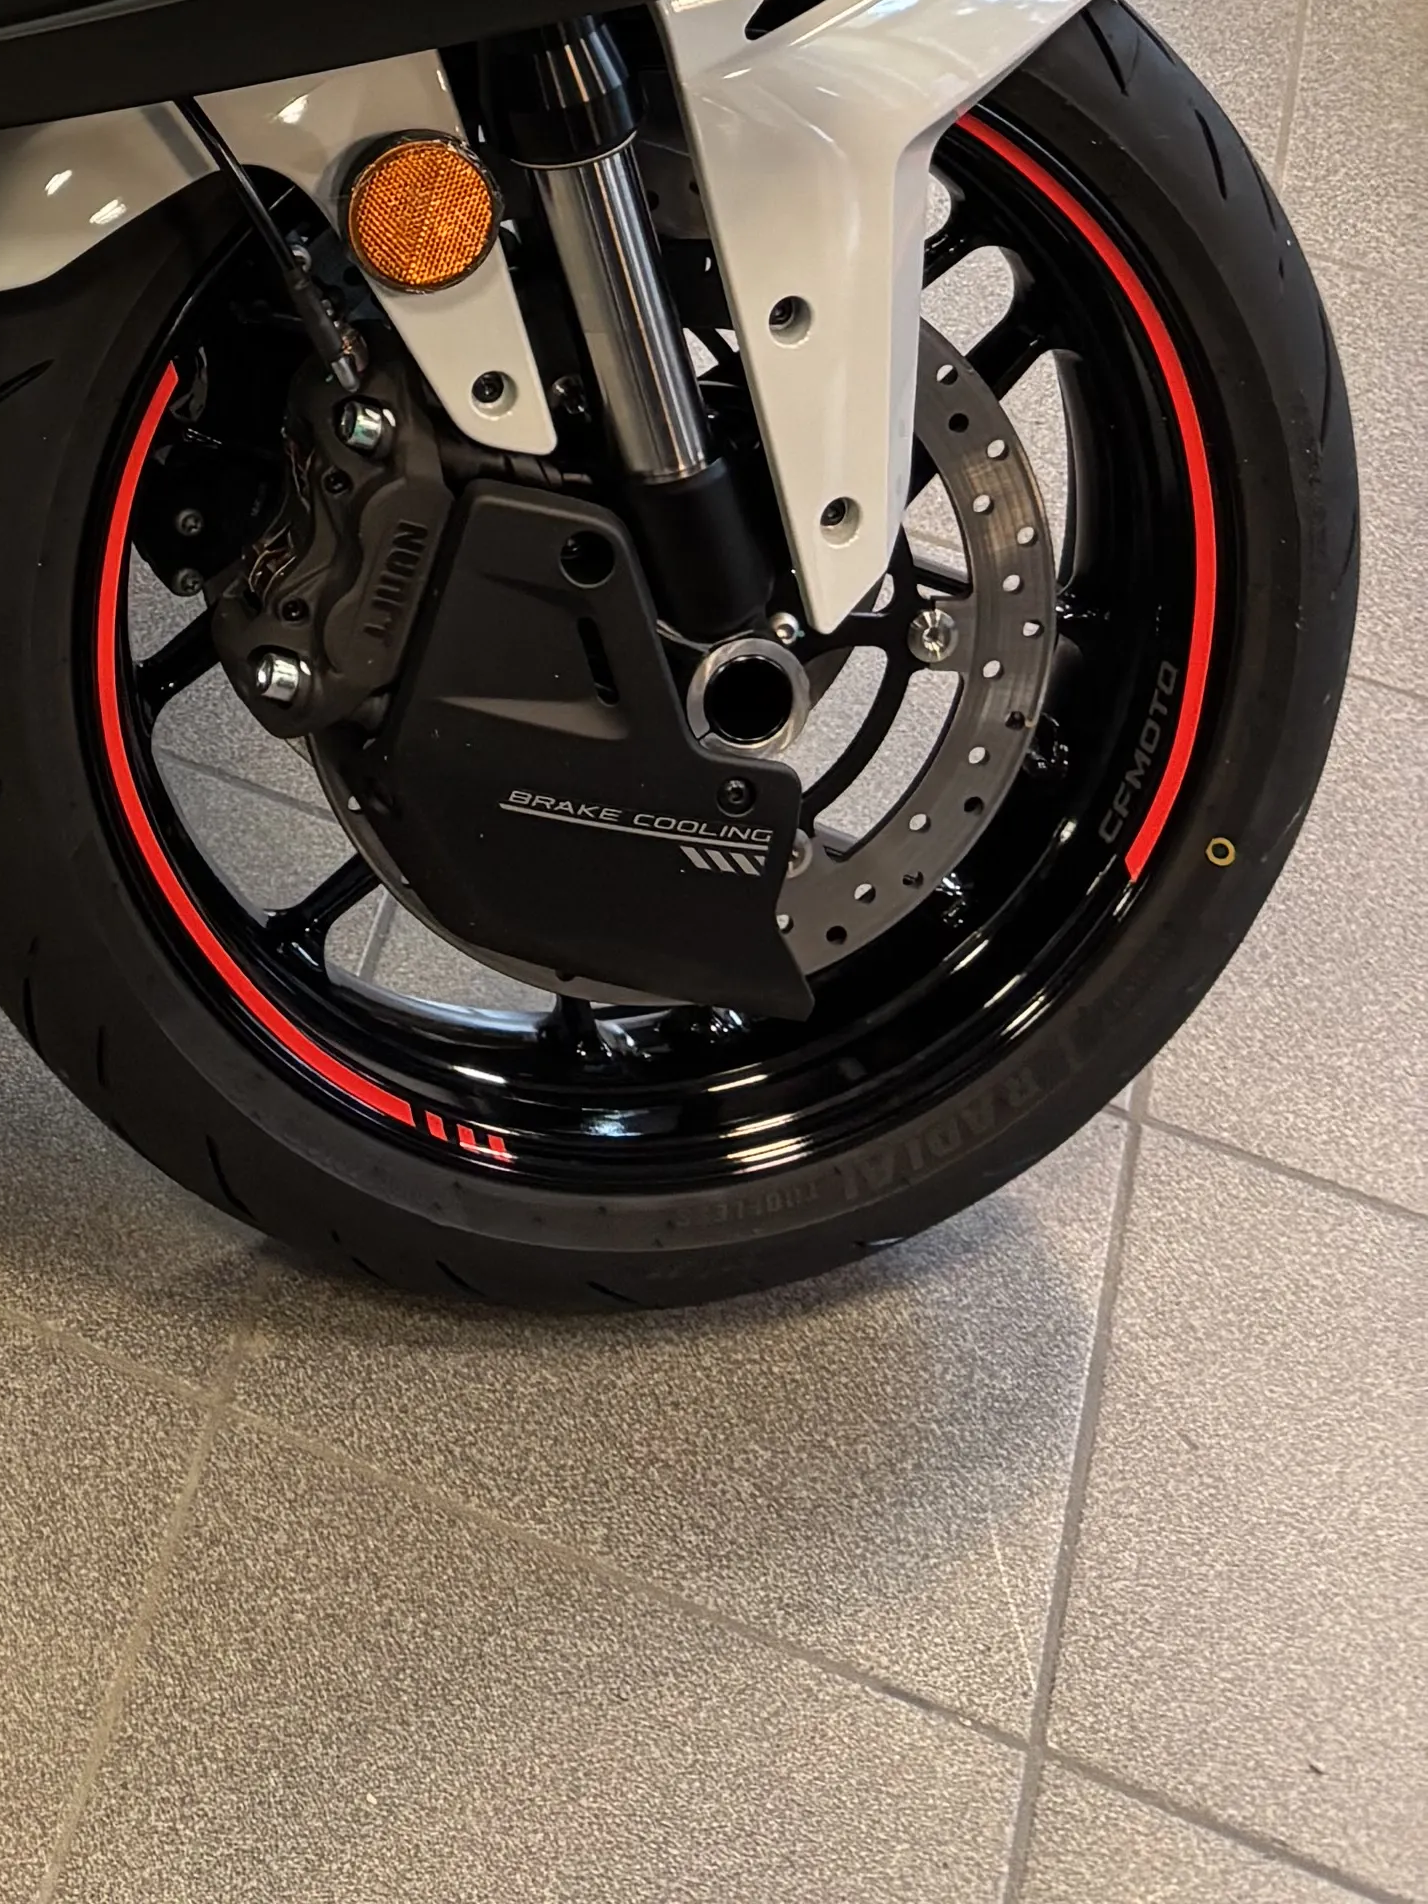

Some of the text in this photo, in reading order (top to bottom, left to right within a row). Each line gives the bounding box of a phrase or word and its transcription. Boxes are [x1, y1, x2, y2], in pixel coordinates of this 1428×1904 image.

[1097, 661, 1180, 848] CFMOTO
[510, 789, 774, 845] BRAKE COOLING
